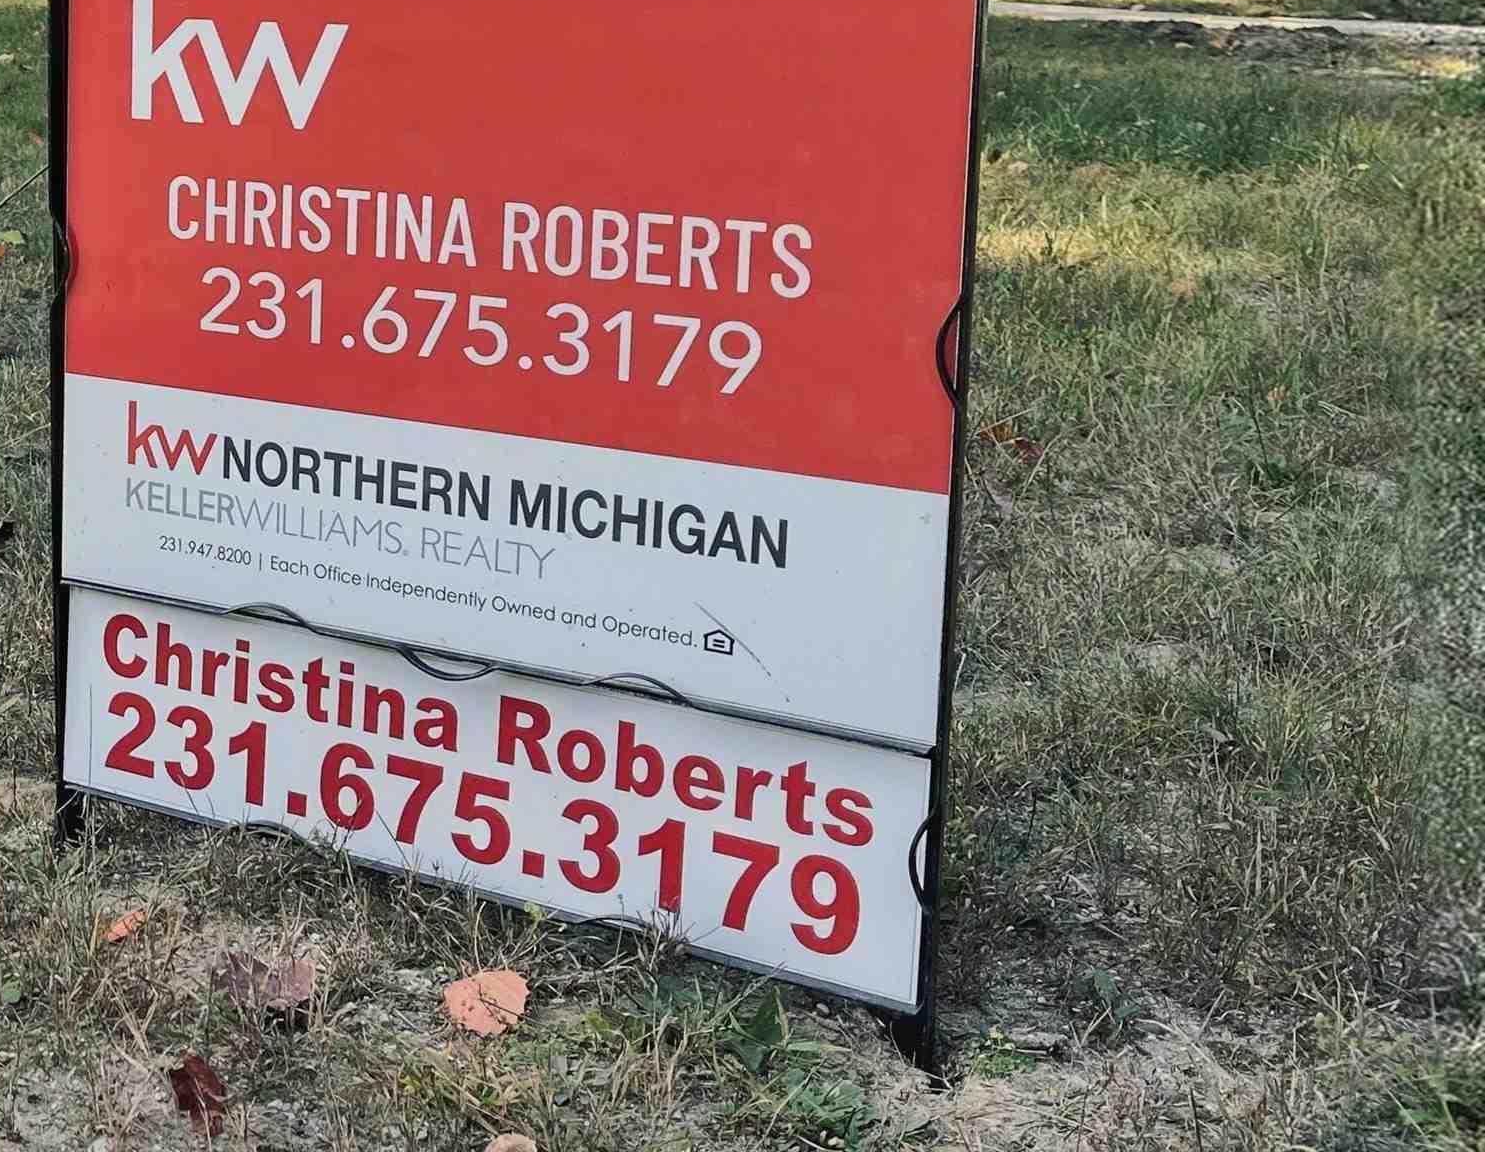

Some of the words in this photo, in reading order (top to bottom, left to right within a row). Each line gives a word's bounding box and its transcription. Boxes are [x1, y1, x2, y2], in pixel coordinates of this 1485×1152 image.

[168, 175, 476, 267] CHRISTINA
[502, 202, 813, 299] ROBERTS
[199, 266, 762, 395] 231.675.3179
[127, 400, 217, 475] kw
[222, 436, 490, 521] NORTHERN
[509, 479, 788, 569] MICHIGAN
[158, 534, 252, 566] 231.947.8200
[269, 555, 309, 578] Each
[313, 563, 362, 587] Office
[366, 572, 488, 613] Independently
[491, 595, 556, 622] Owned
[561, 611, 597, 629] and
[602, 615, 698, 649] Operated.
[420, 526, 556, 579] REALTY
[102, 613, 459, 752] Christina
[497, 696, 875, 846] Roberts
[103, 692, 861, 955] 231.675.3179
